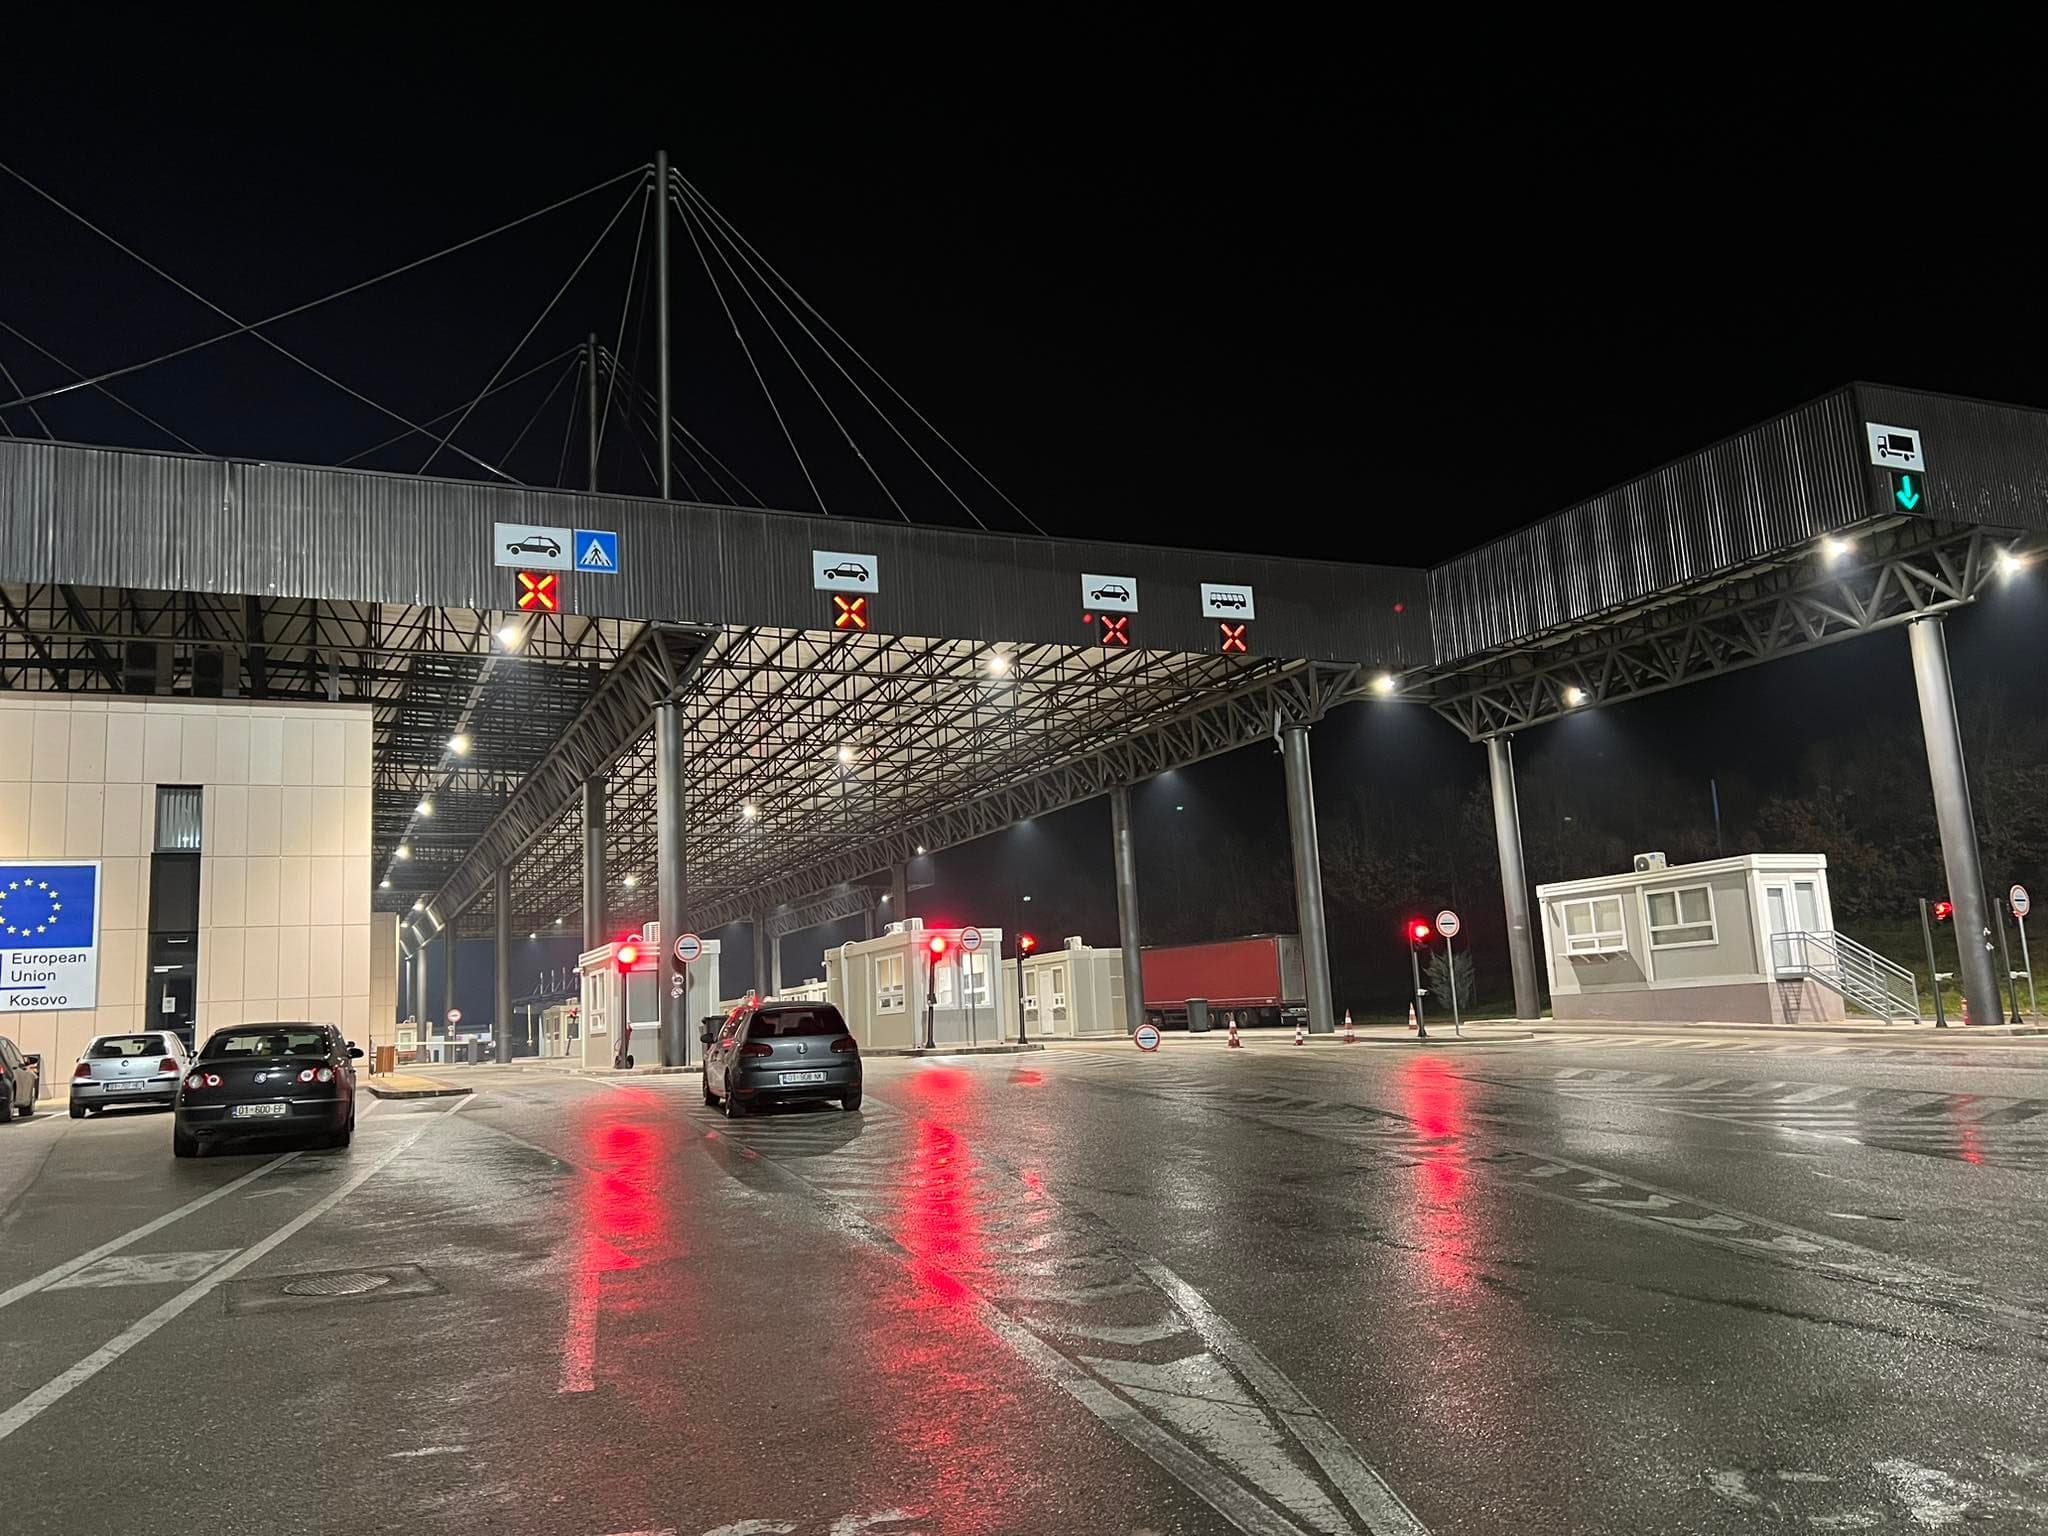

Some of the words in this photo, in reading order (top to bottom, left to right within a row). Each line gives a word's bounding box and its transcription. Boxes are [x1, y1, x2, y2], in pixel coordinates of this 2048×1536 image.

[12, 952, 87, 966] European
[11, 969, 57, 983] Union
[9, 994, 68, 1007] Kosovo
